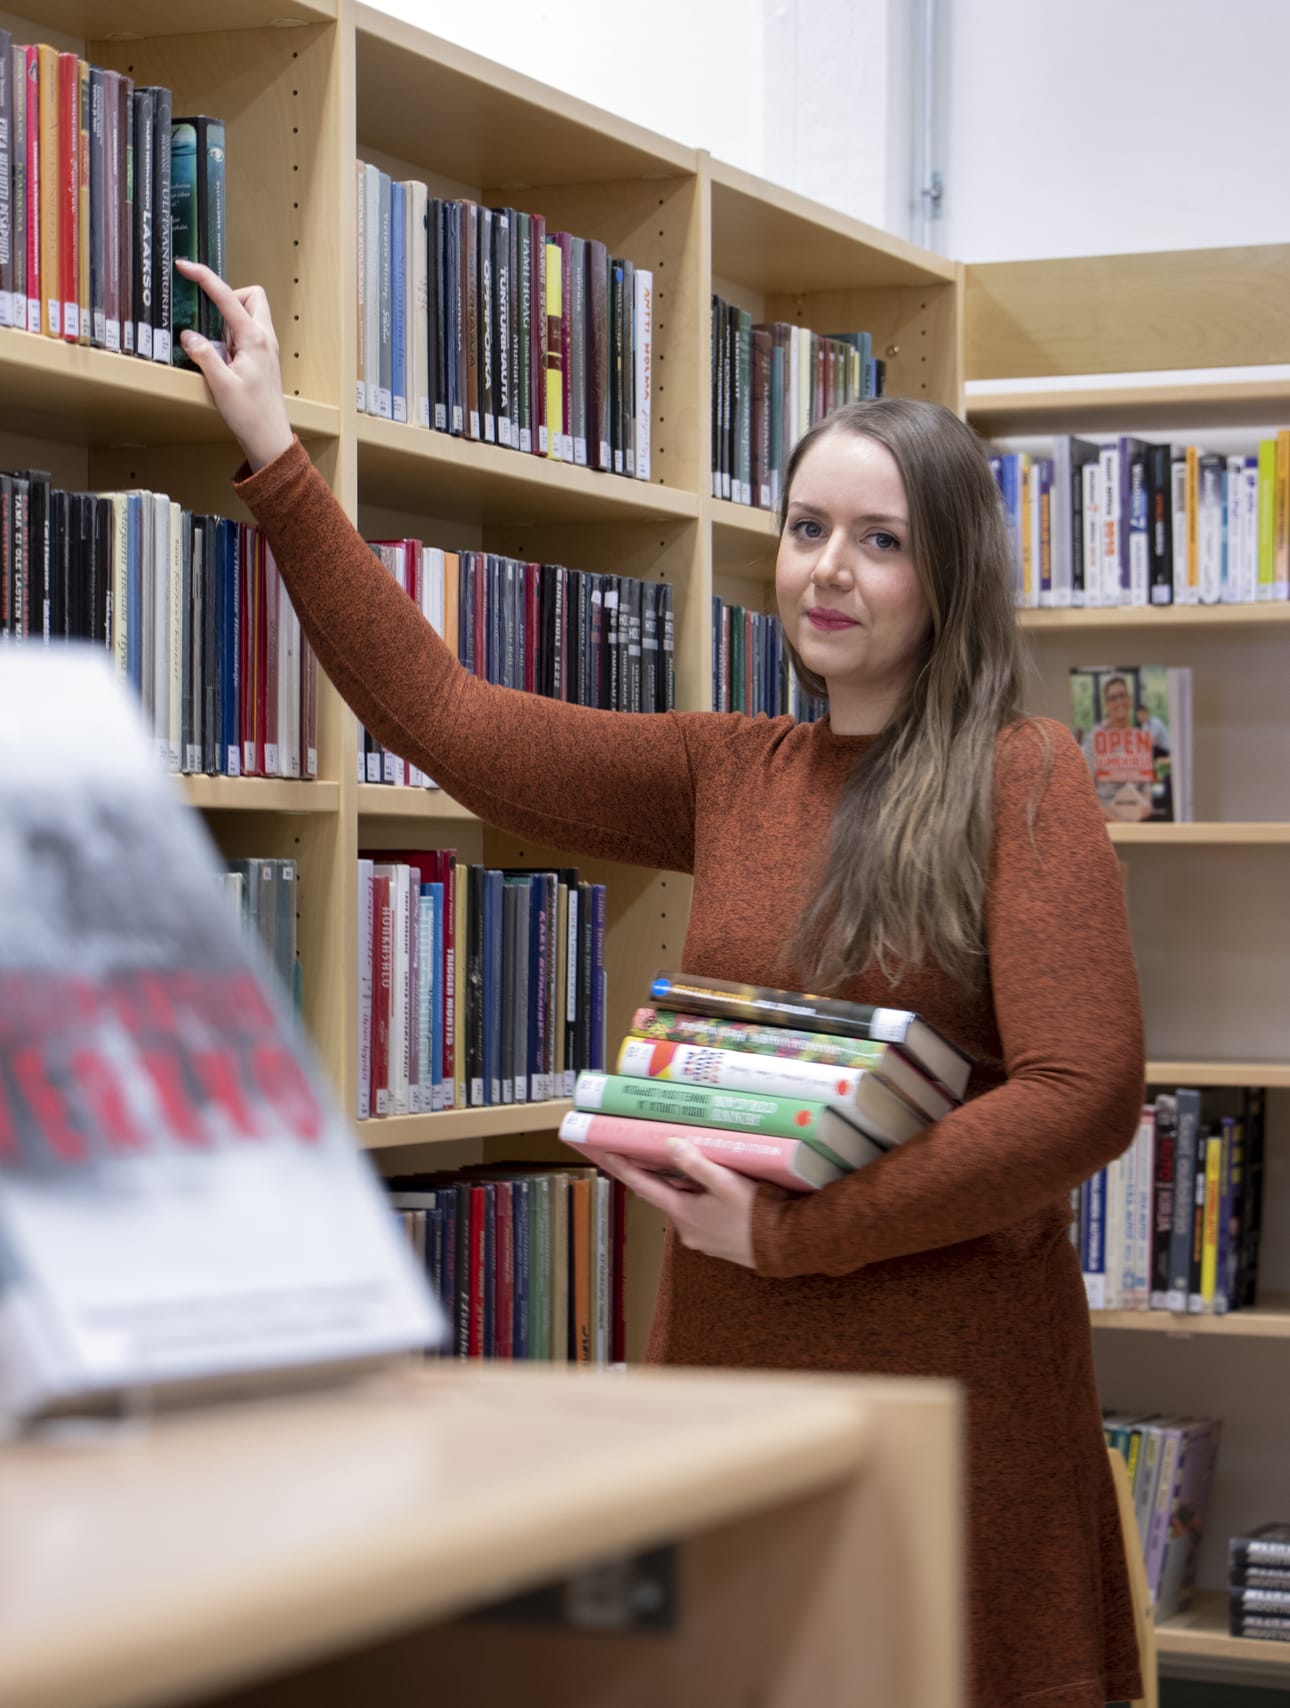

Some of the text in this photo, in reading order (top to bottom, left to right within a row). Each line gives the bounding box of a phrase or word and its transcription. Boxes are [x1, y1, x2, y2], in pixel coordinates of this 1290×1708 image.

[143, 210, 151, 307] LAAKSO
[643, 288, 651, 334] ANTTI
[500, 266, 508, 408] TUNTURIHAUTA
[554, 582, 562, 616] ANNE
[553, 618, 562, 648] HOLT
[1094, 731, 1152, 754] OPEN
[446, 948, 454, 995] TRIGGER
[1159, 1137, 1174, 1181] AUTO
